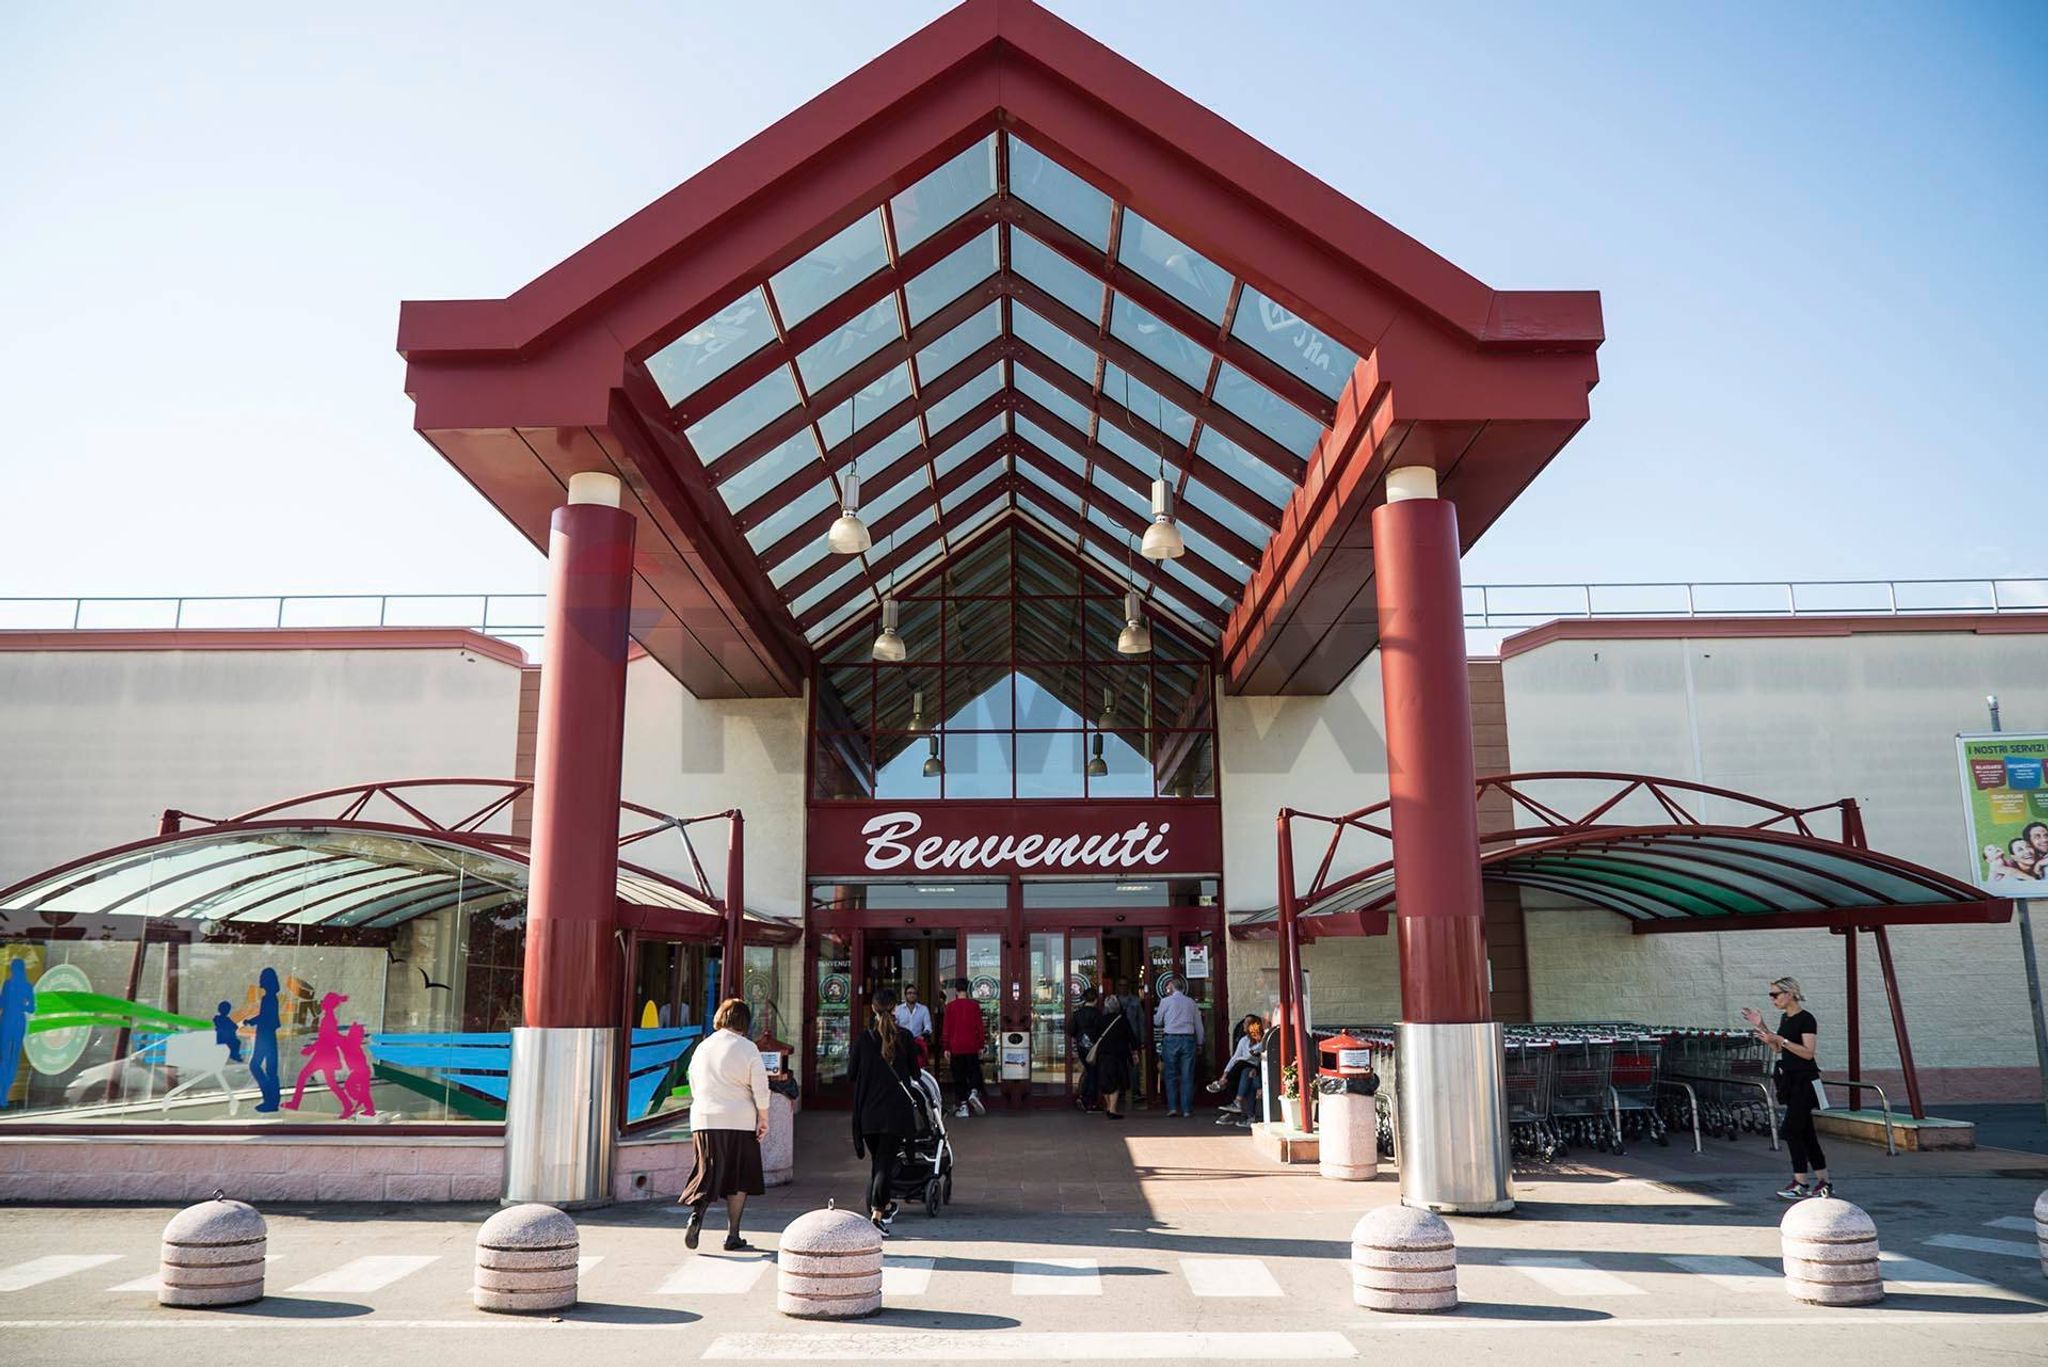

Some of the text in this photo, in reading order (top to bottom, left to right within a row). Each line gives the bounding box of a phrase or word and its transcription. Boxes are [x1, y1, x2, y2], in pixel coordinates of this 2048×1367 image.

[1974, 745, 2008, 755] NOSTRI
[2010, 743, 2046, 753] SERVIZI
[861, 811, 1171, 870] Benvenuti
